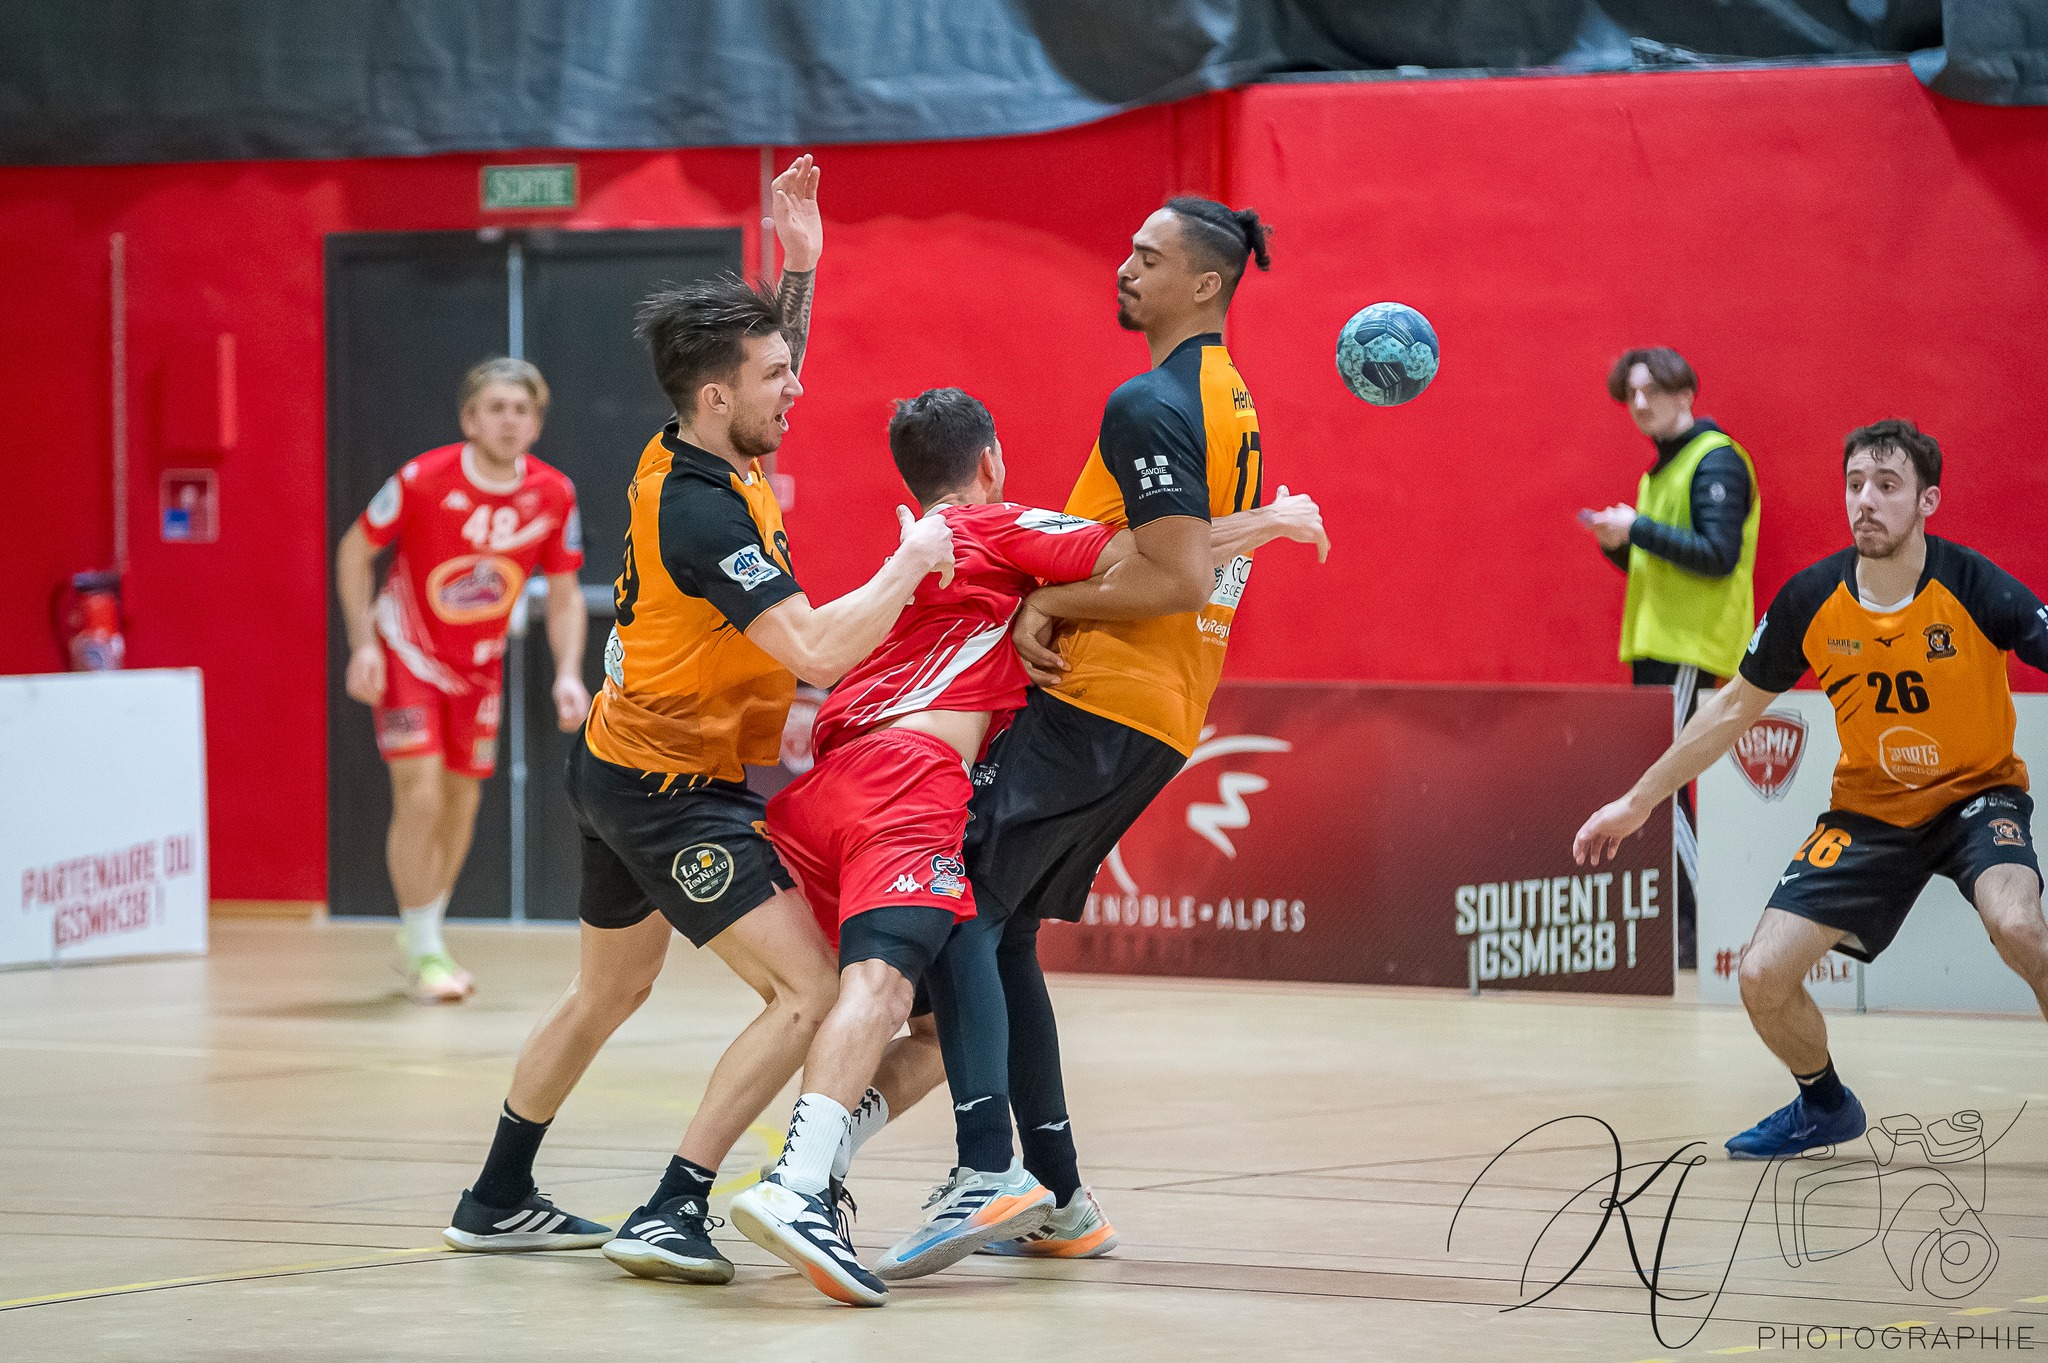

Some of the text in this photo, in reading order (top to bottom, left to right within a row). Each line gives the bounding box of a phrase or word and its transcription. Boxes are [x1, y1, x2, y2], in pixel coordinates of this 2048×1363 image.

[1141, 466, 1167, 477] SAVOIE
[1867, 670, 1930, 715] 26
[1886, 744, 1940, 767] SPORTS
[22, 832, 195, 914] PARTENAIRE DU
[680, 862, 700, 879] LE
[53, 888, 150, 949] GSMH38
[1455, 868, 1660, 936] SOUTIENT LE
[1478, 921, 1617, 982] GSMH38
